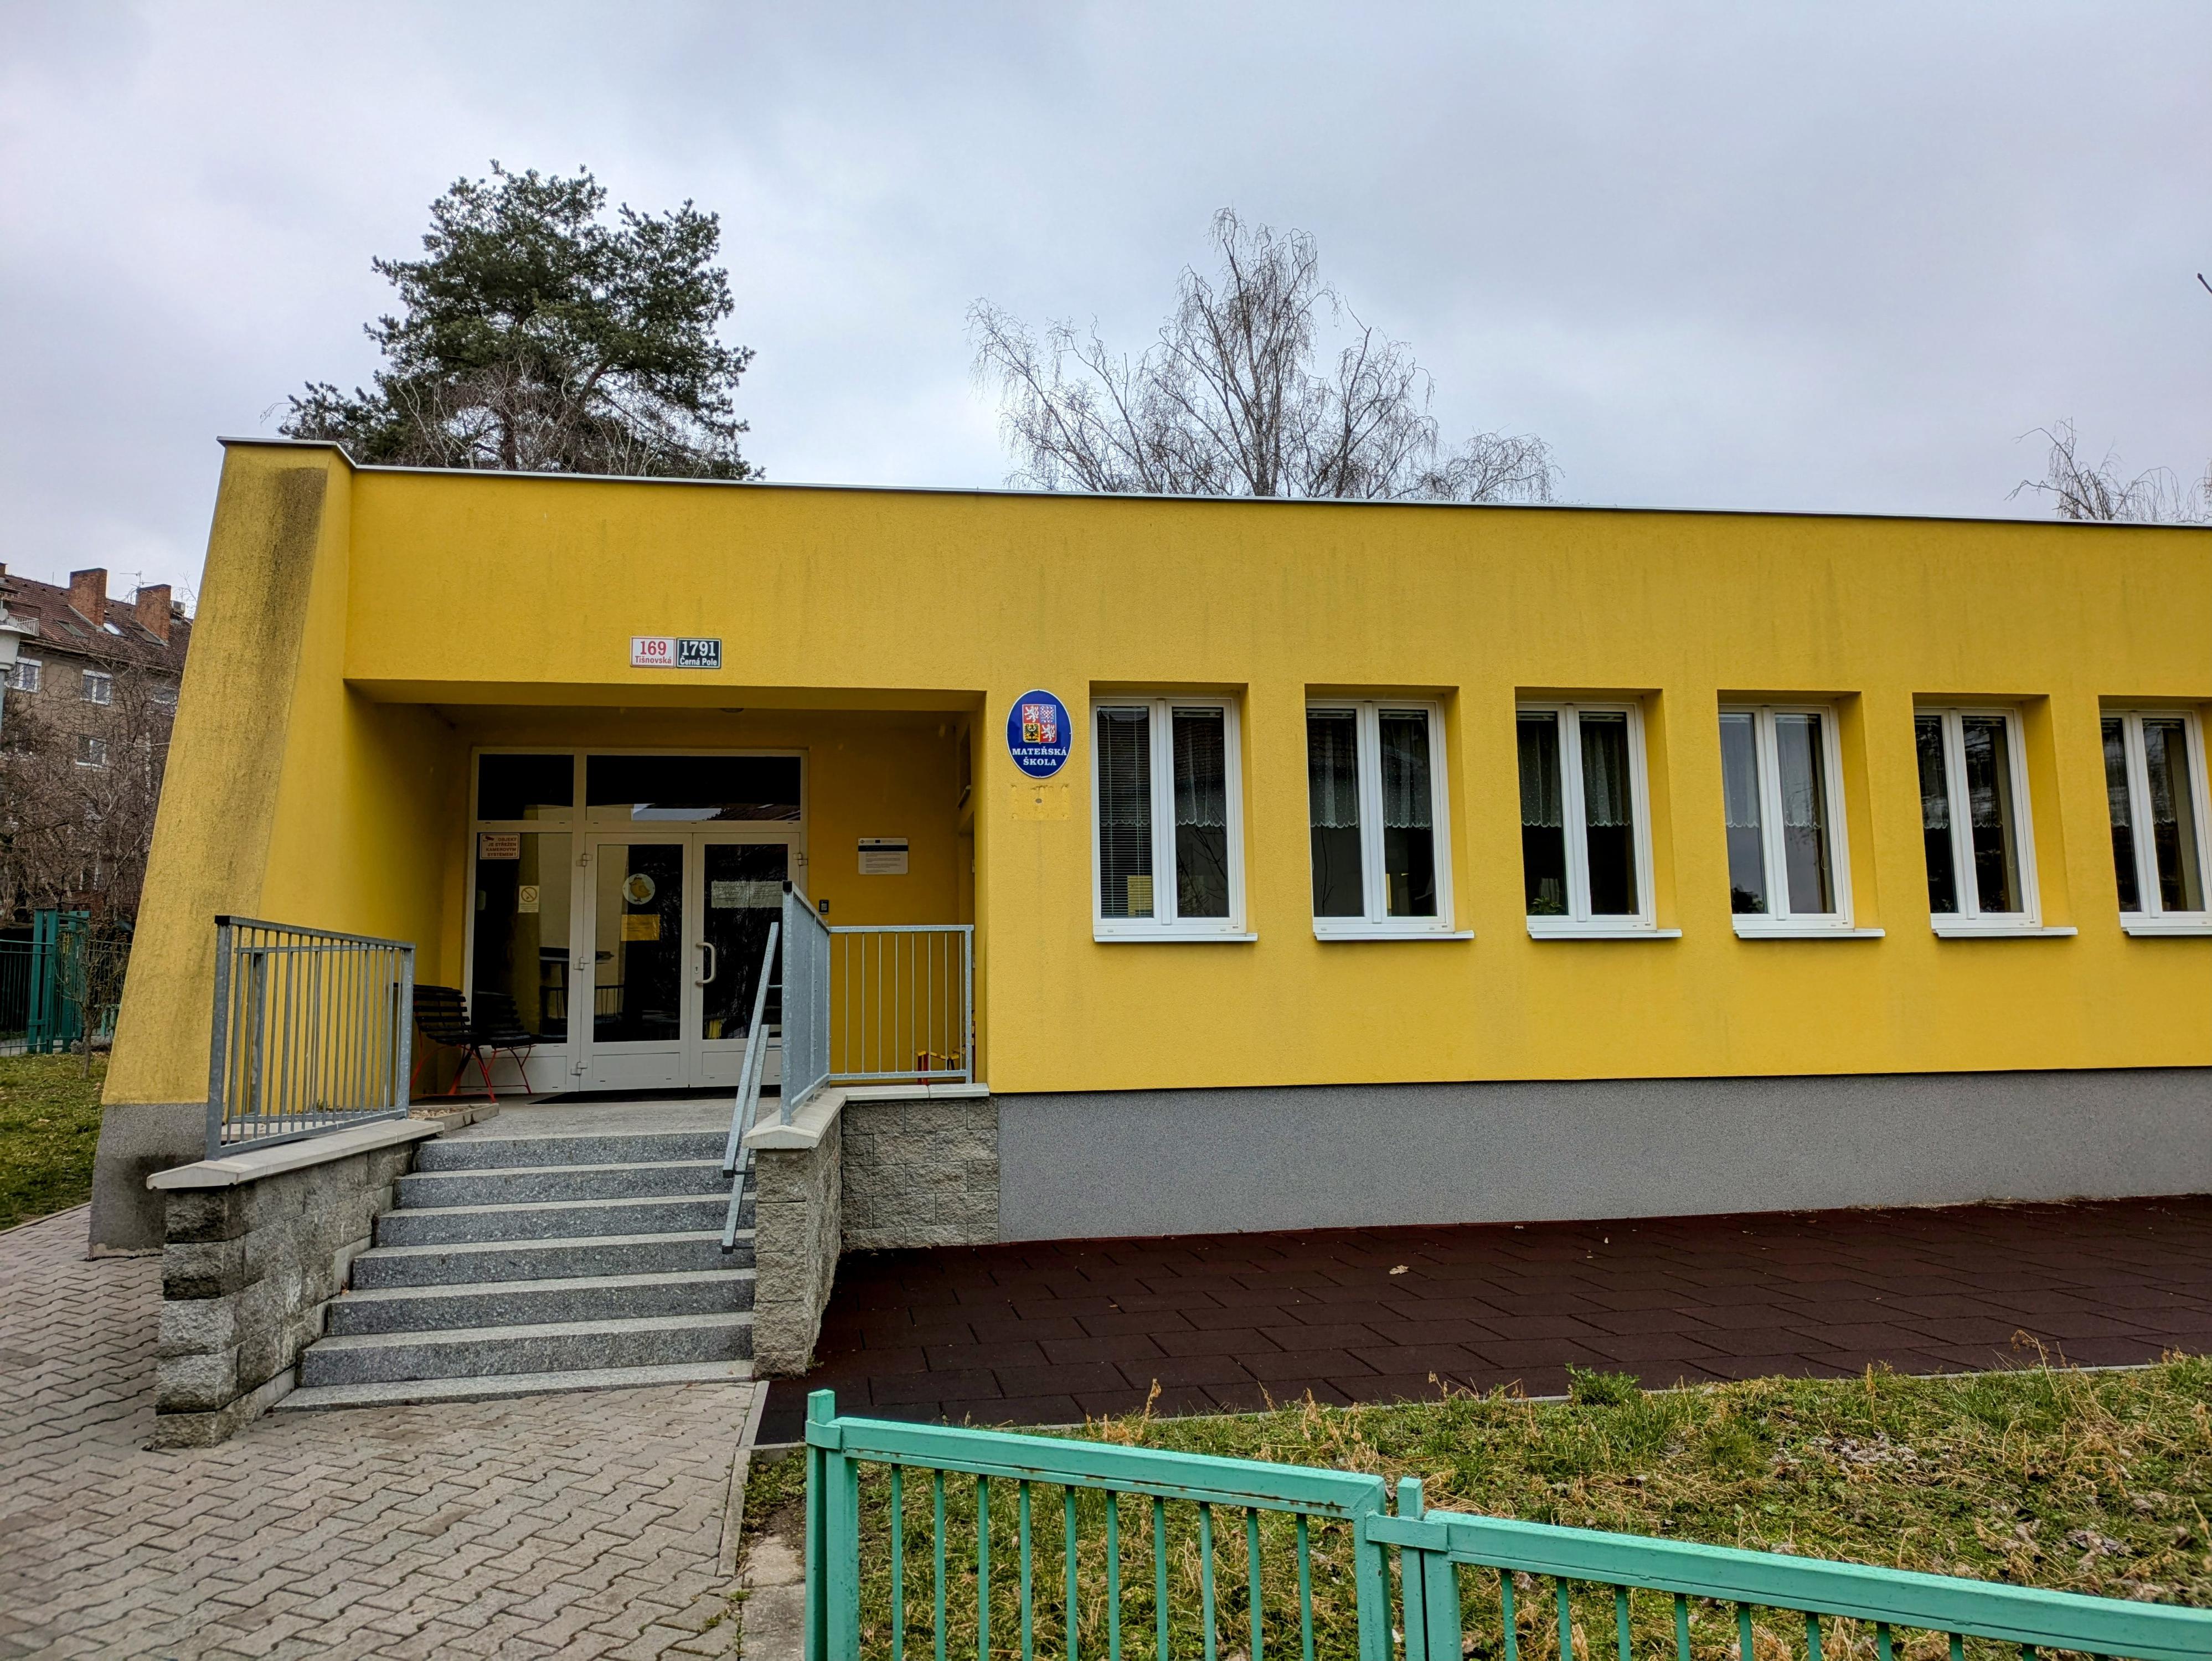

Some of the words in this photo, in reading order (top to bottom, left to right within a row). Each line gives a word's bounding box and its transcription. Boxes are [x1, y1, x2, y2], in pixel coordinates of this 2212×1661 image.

[640, 641, 667, 656] 169
[682, 641, 716, 656] 1791
[635, 656, 672, 664] Tišnovská
[680, 656, 700, 666] Černá
[1012, 746, 1067, 756] MATEŘSKÁ
[1023, 756, 1056, 766] ŠKOLA
